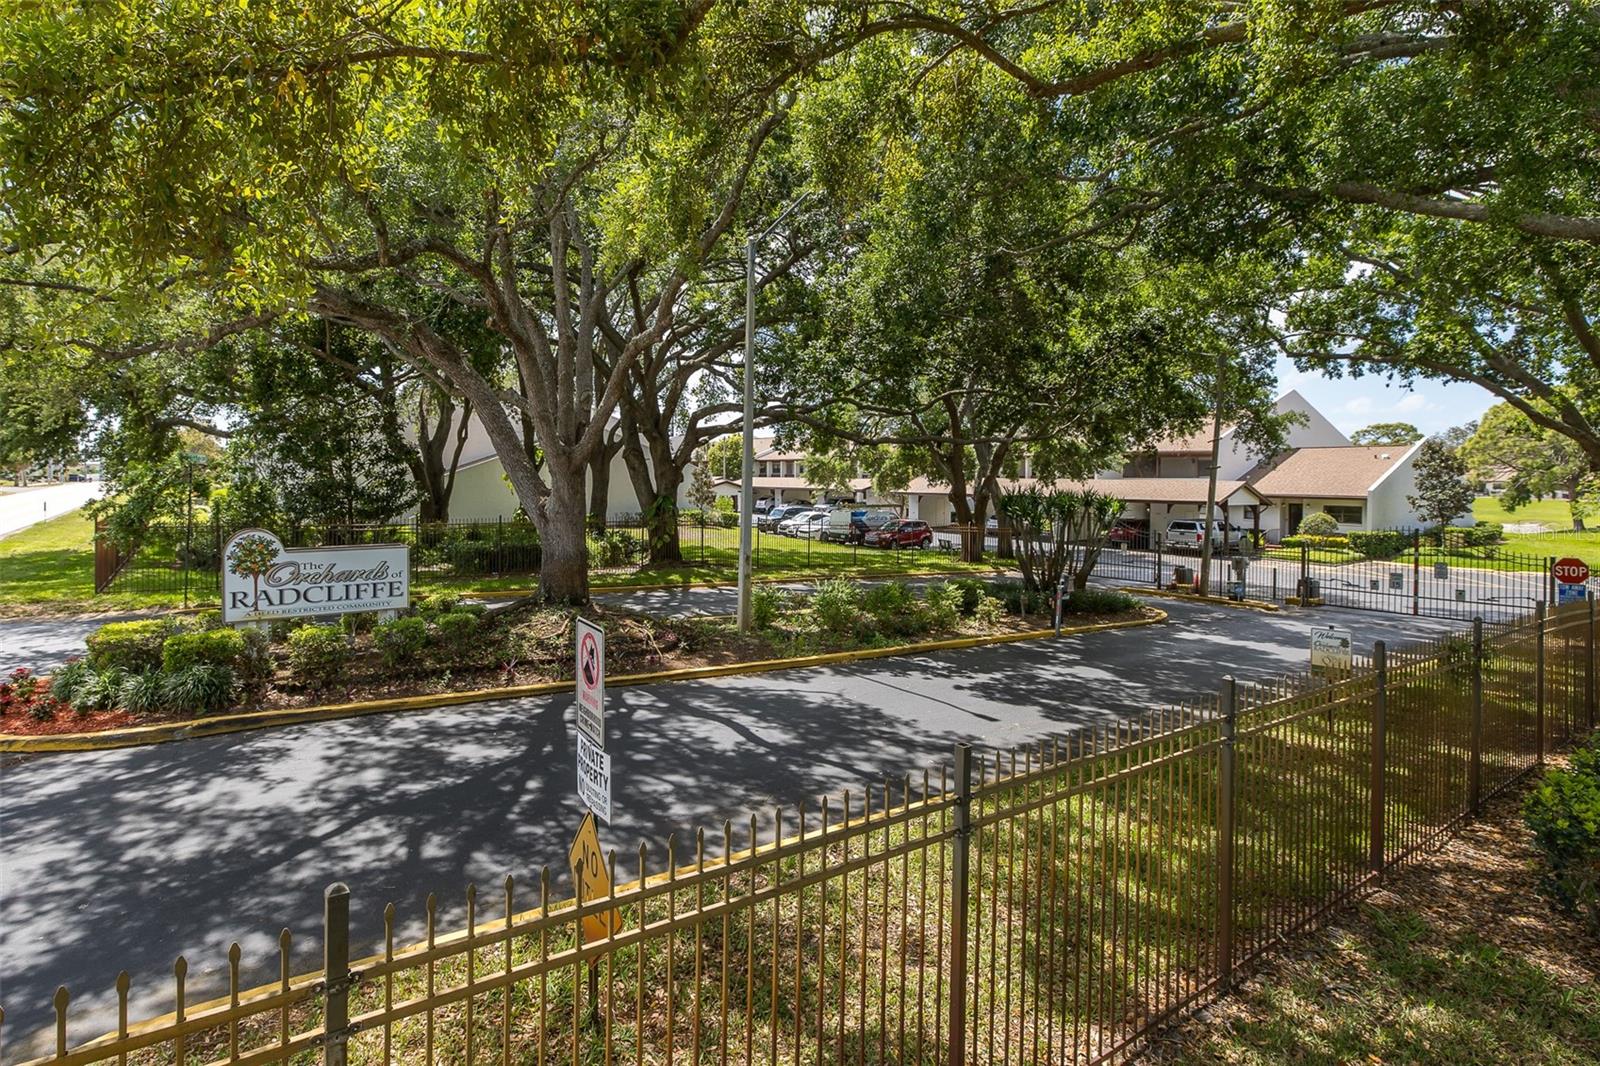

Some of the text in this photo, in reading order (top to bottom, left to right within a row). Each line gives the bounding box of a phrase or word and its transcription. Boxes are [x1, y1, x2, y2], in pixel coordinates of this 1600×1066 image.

[264, 560, 404, 588] Orchards of
[301, 562, 324, 570] The
[1555, 565, 1588, 577] STOP
[229, 580, 404, 610] RADCLIFFE
[281, 605, 335, 615] RESTRICTED
[336, 600, 392, 610] COMMUNITY
[581, 738, 604, 771] PRIVATE
[578, 753, 609, 792] PROPERTY
[583, 840, 599, 879] NO
